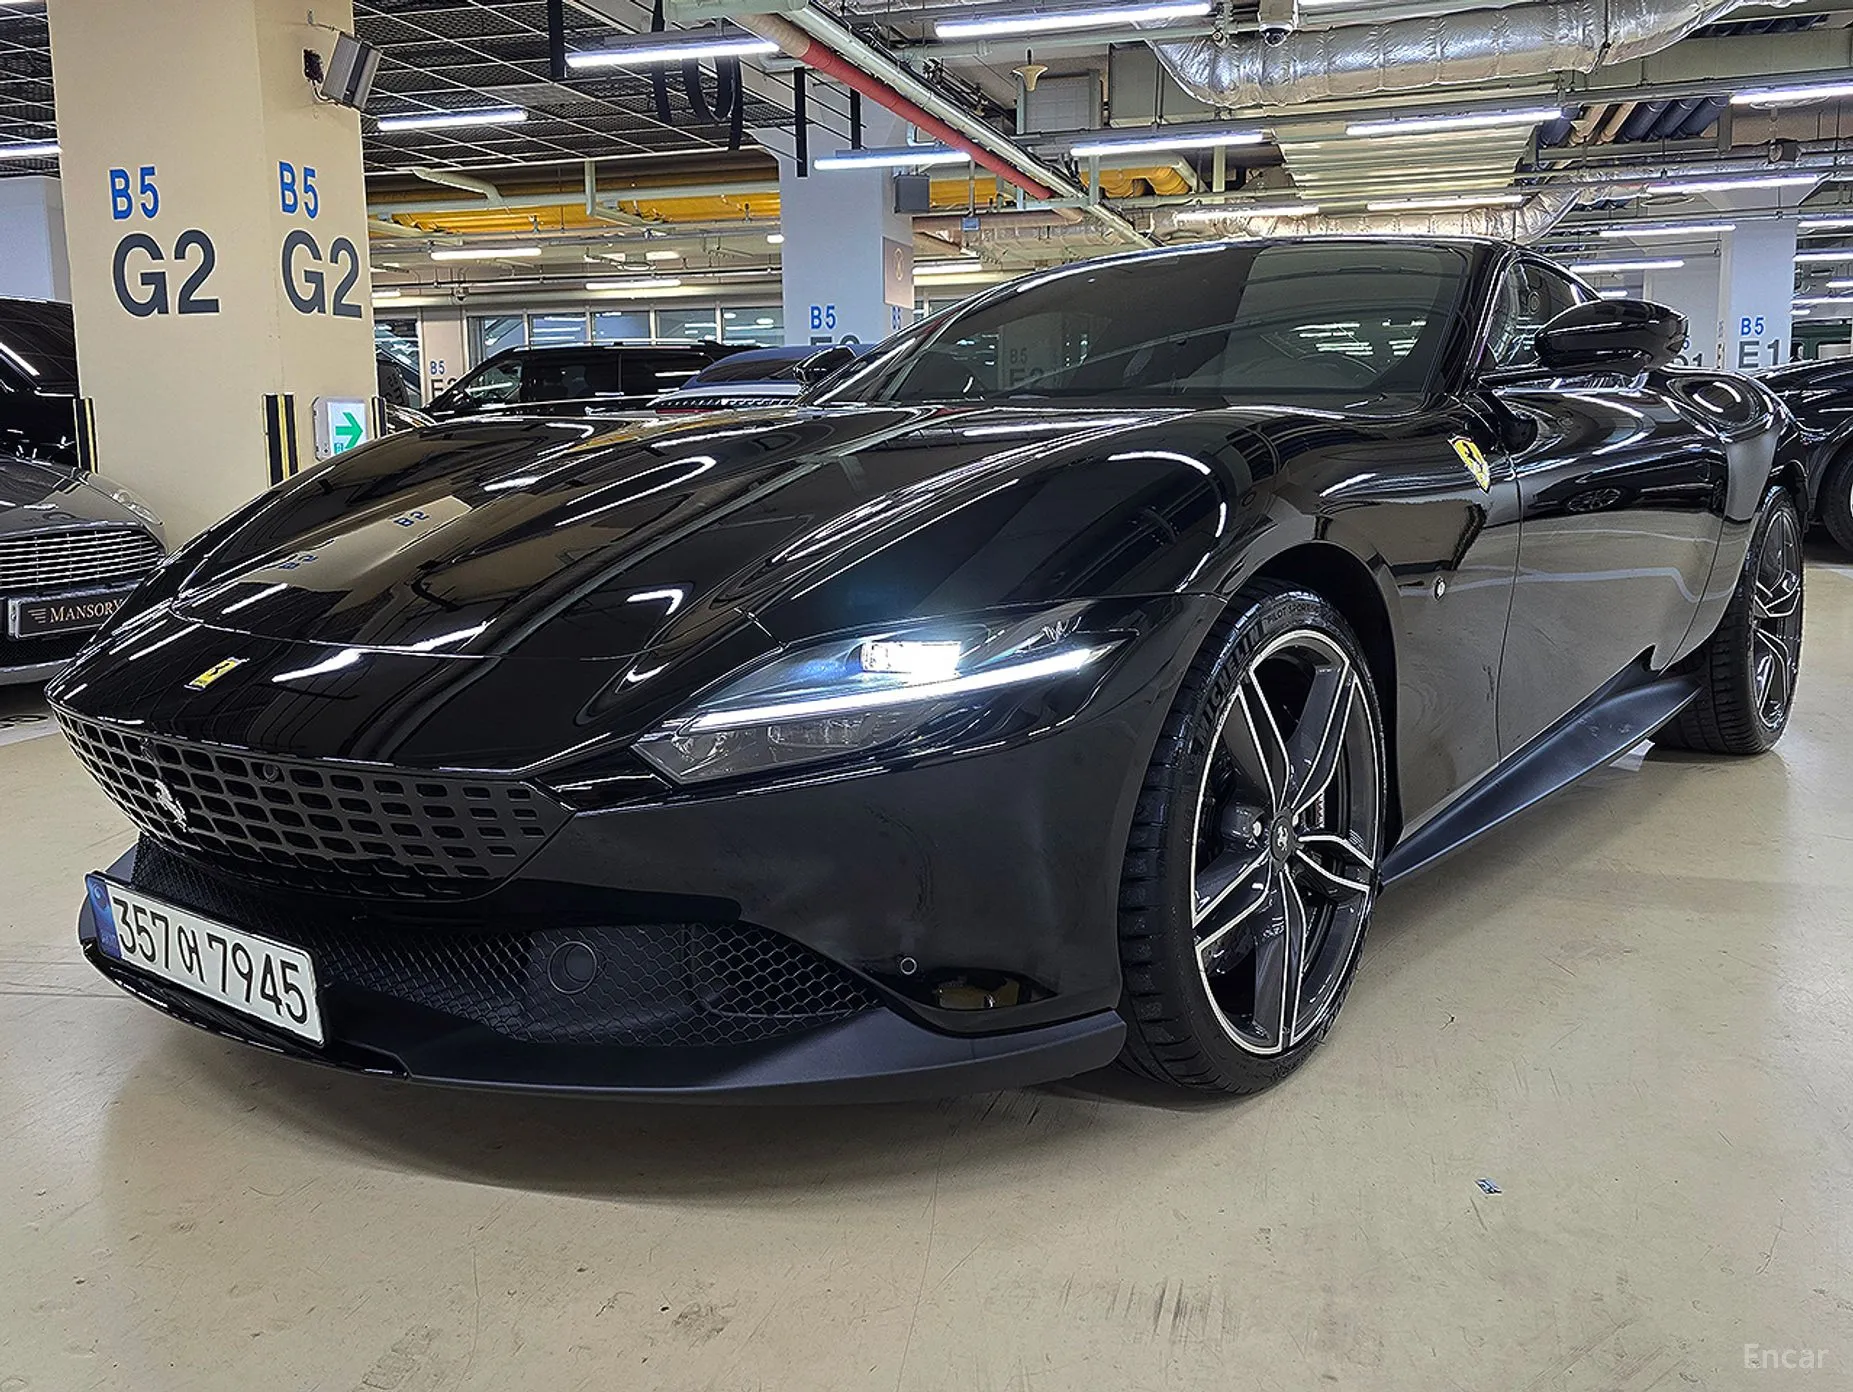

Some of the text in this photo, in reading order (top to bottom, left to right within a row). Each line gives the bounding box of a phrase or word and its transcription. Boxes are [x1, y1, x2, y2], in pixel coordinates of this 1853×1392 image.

[109, 166, 160, 220] B5
[279, 161, 319, 219] B5
[113, 229, 220, 317] G2
[281, 230, 362, 319] G2
[810, 305, 837, 329] B5
[1741, 317, 1764, 336] B5
[430, 361, 445, 375] B5
[1738, 340, 1780, 369] E1
[50, 600, 123, 623] MANSORY
